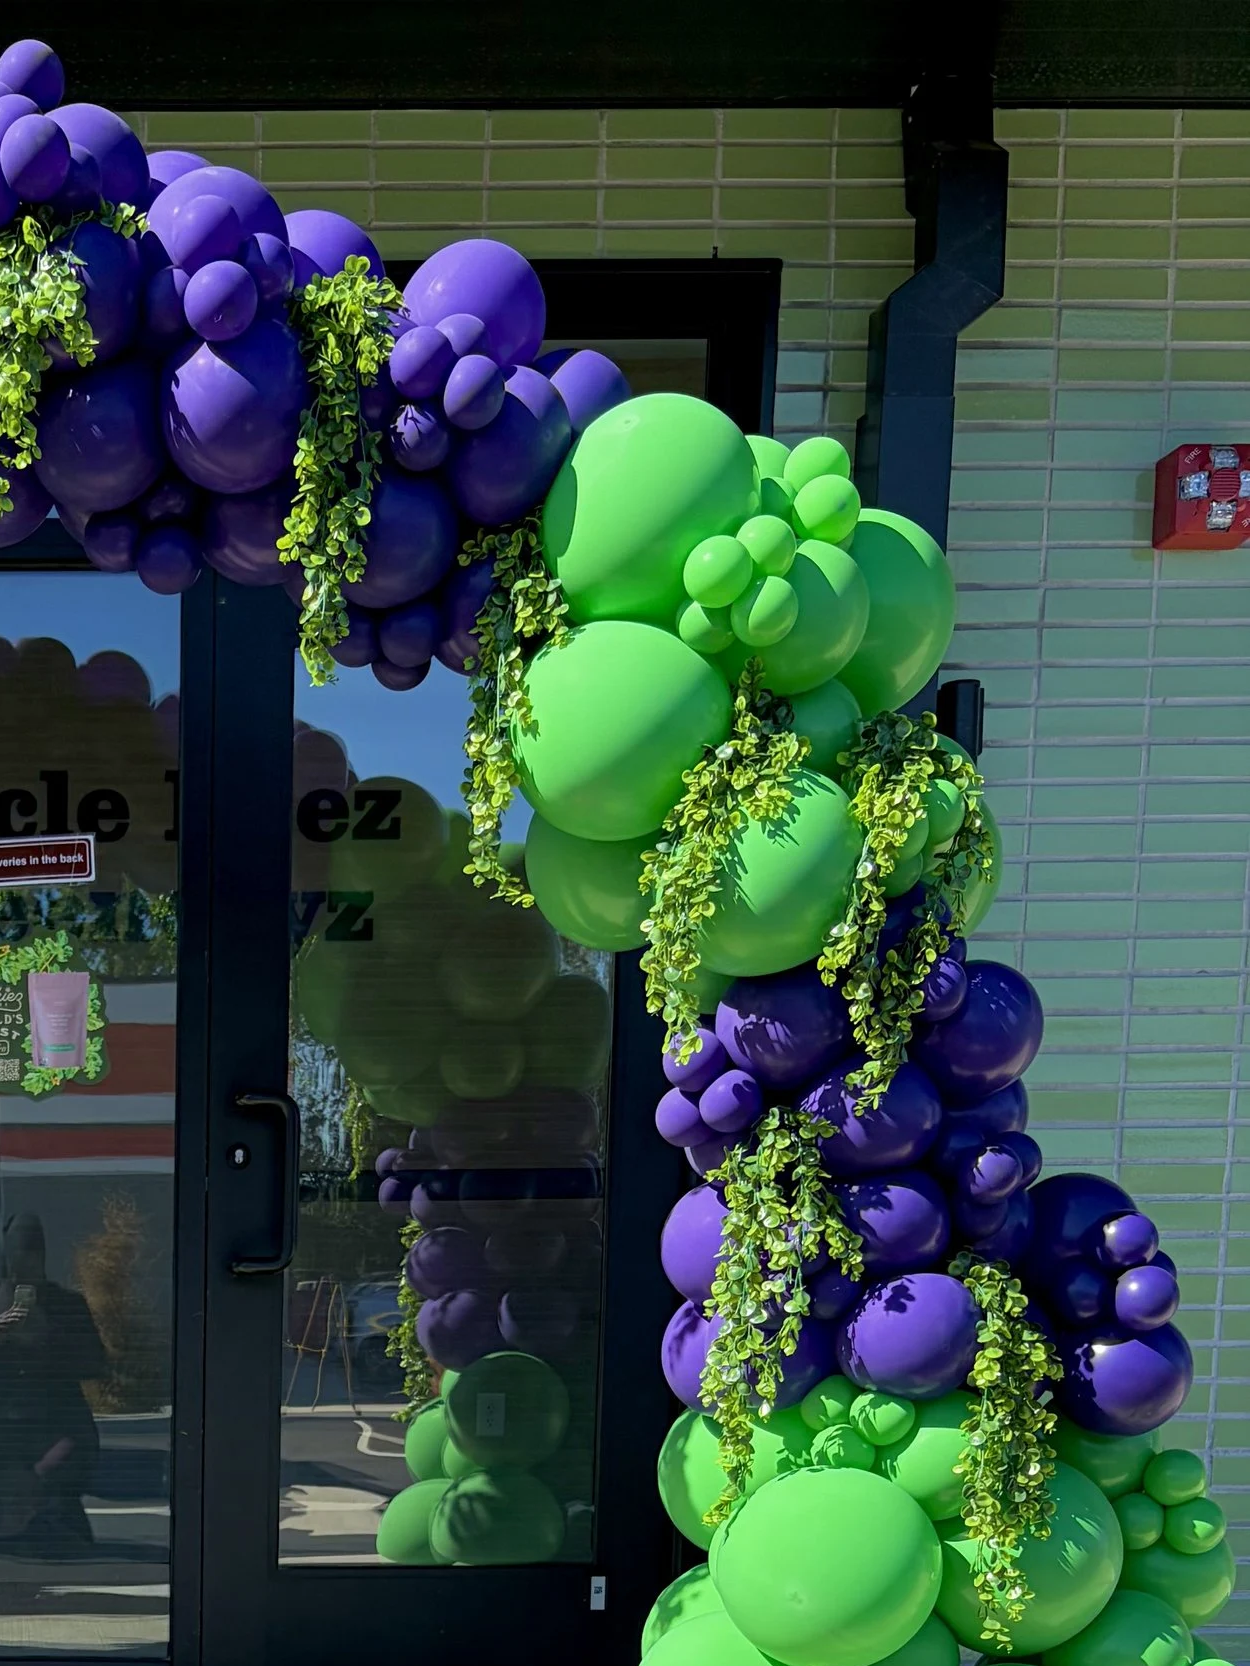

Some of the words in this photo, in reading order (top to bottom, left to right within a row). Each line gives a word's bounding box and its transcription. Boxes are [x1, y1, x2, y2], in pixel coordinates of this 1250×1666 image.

[1184, 447, 1202, 465] FIRE
[29, 855, 39, 866] in
[41, 854, 57, 865] the
[59, 852, 84, 864] back
